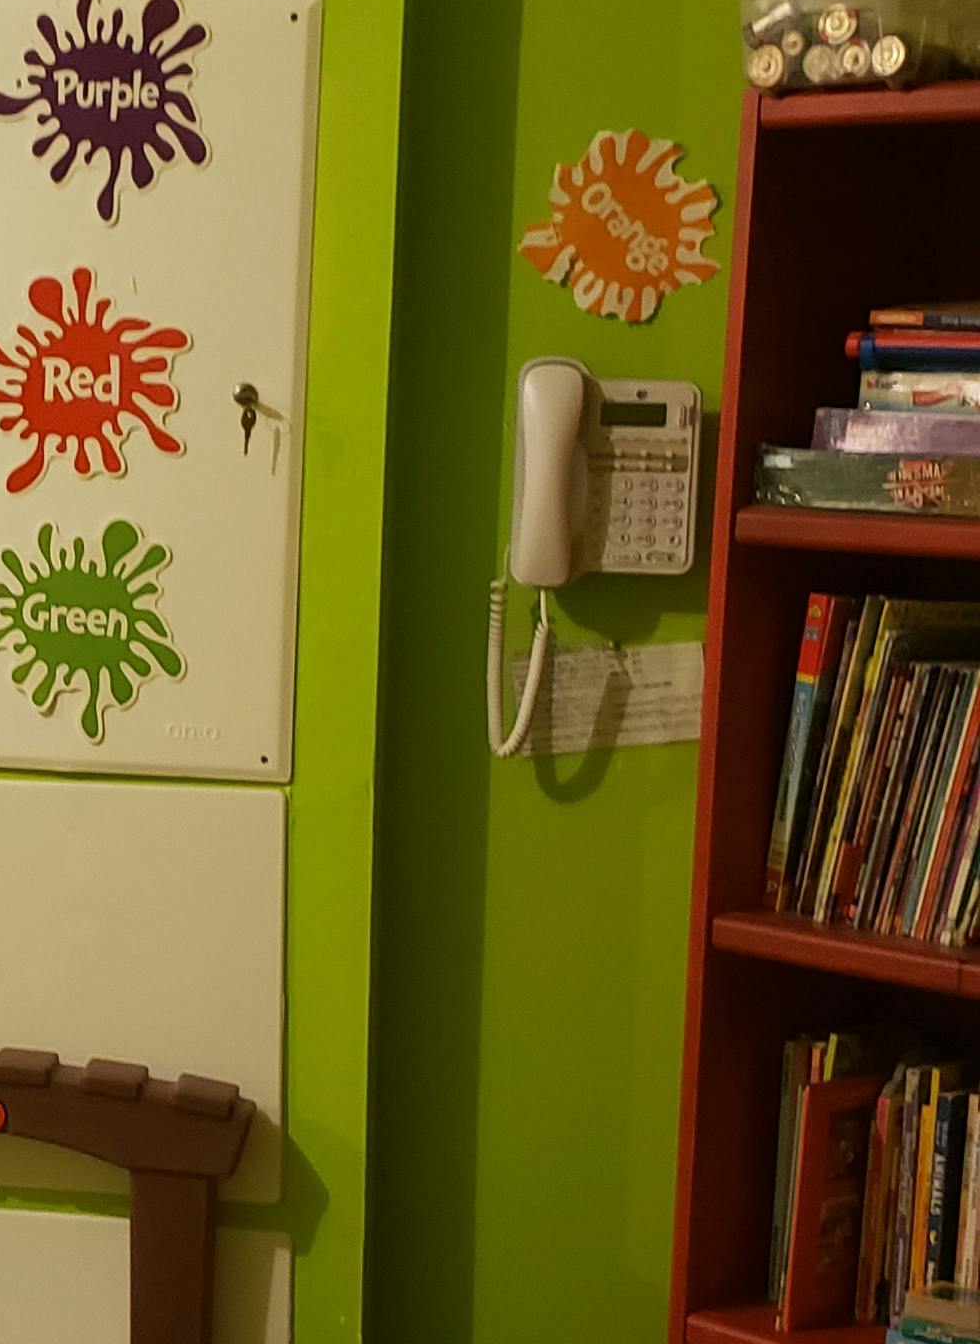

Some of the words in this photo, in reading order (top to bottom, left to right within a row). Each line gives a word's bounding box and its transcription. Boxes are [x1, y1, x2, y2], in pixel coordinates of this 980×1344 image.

[53, 69, 160, 123] Purple
[581, 181, 669, 276] Orange
[41, 356, 121, 407] Red
[22, 592, 129, 640] Green
